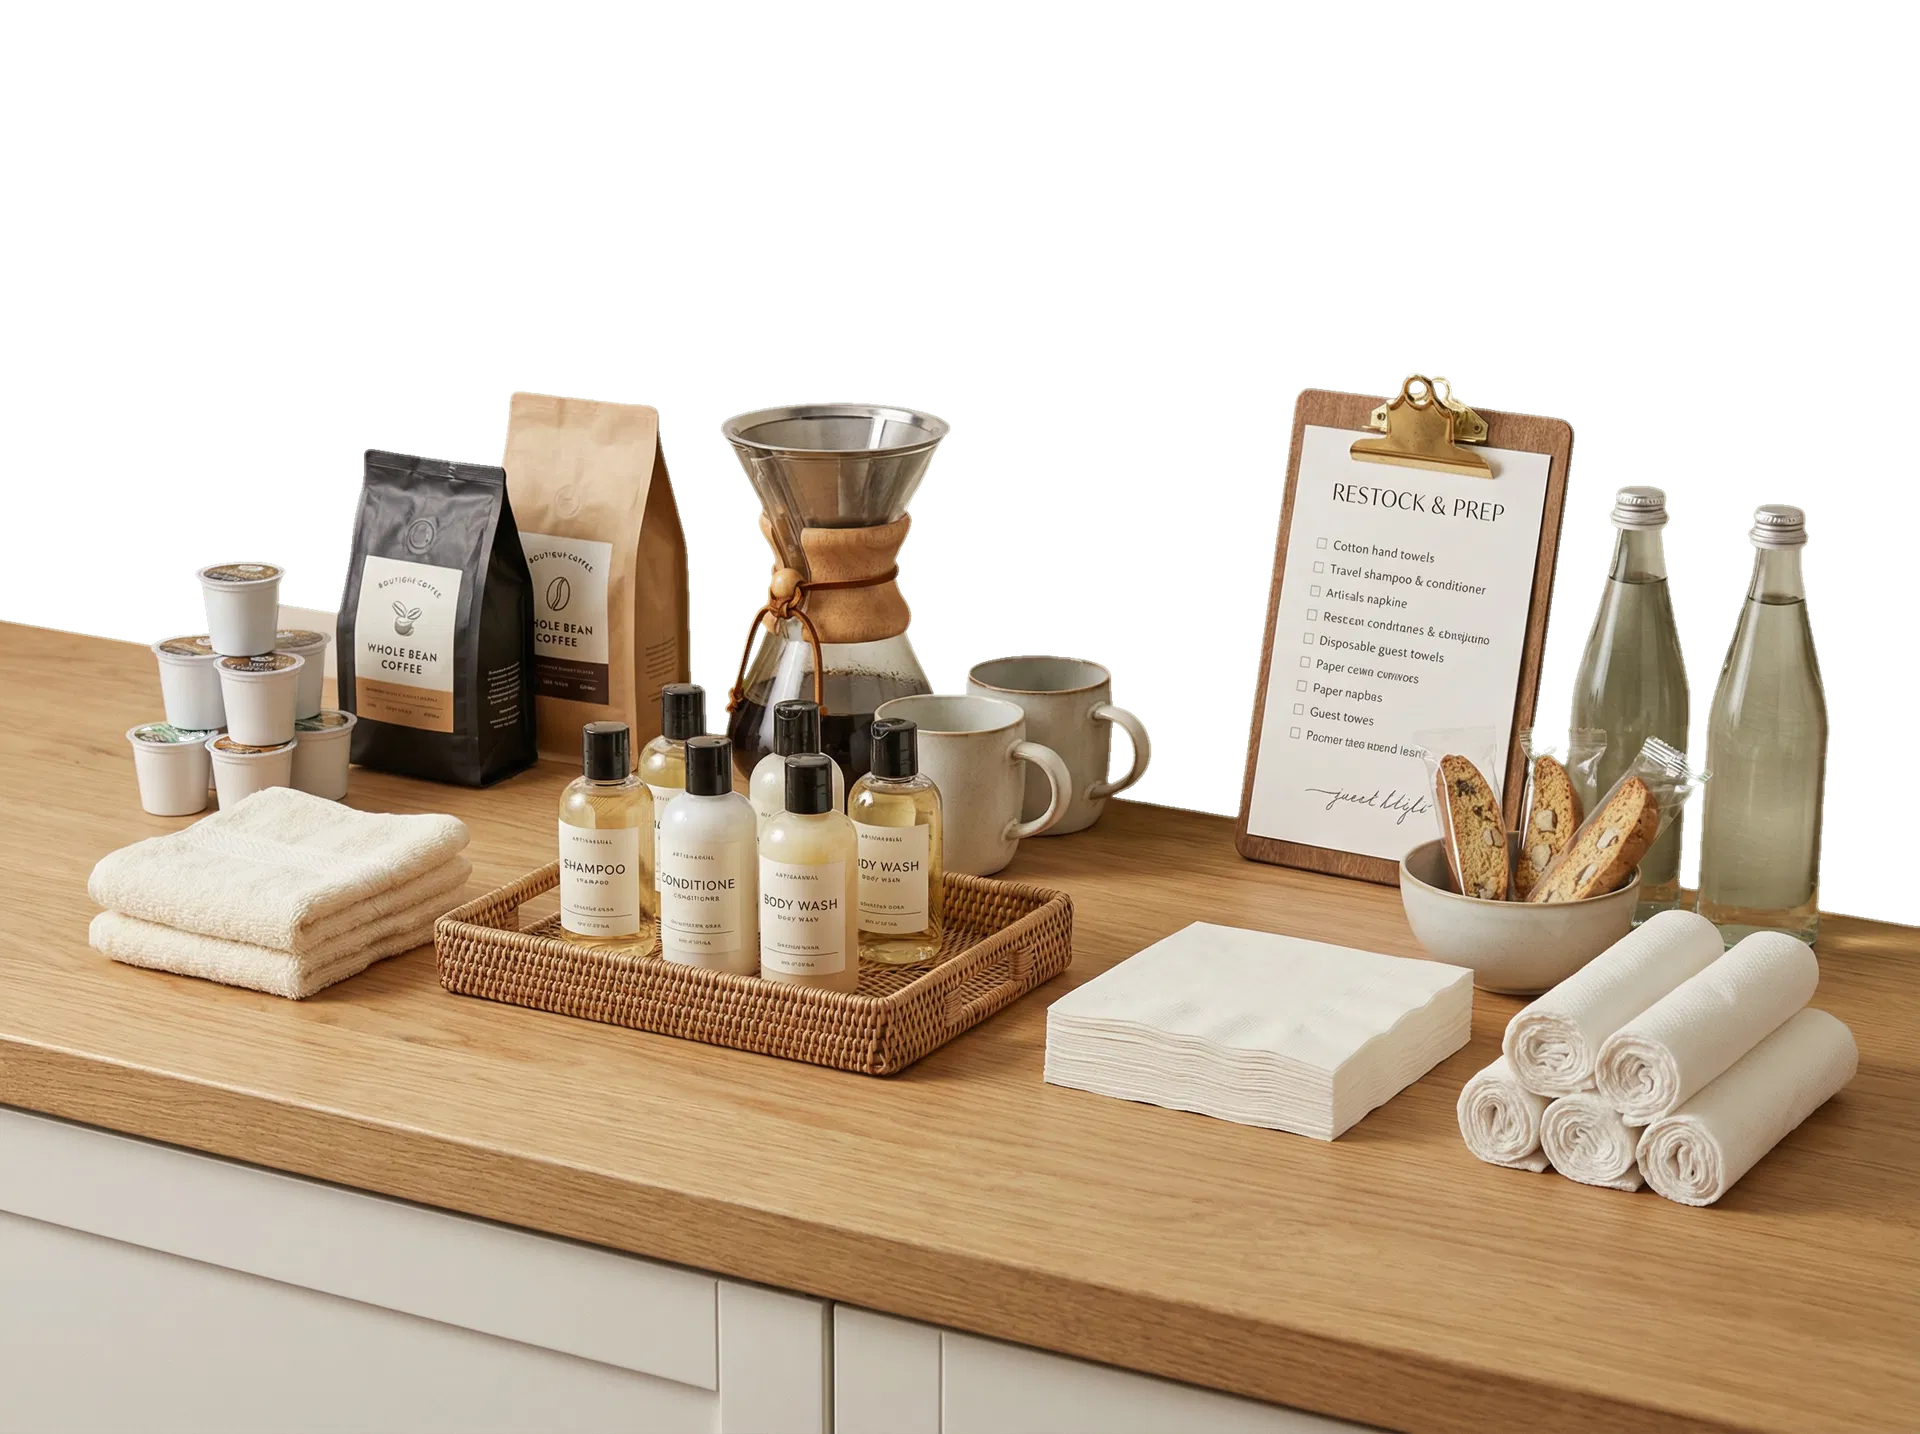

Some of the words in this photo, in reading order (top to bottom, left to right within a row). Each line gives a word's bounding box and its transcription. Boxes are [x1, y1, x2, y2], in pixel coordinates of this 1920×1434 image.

[1332, 482, 1426, 512] RESTOCK
[1431, 496, 1446, 516] &
[1453, 498, 1505, 522] PREP
[1333, 540, 1369, 555] Cotton
[1372, 544, 1398, 558] hand
[1400, 551, 1435, 563] towels
[1330, 563, 1362, 578] Travel
[1364, 569, 1412, 586] shampoo
[1415, 575, 1424, 587] &
[1426, 578, 1486, 596] conditioner
[1367, 595, 1408, 609] napkine
[533, 619, 560, 631] HOLE
[563, 623, 593, 635] BEAN
[1427, 626, 1435, 637] &
[536, 632, 577, 647] COFFEE
[367, 642, 405, 658] WHOLE
[408, 649, 437, 662] BEAN
[1319, 635, 1376, 652] Disposable
[1378, 645, 1407, 657] guest
[1410, 650, 1444, 663] towels
[381, 659, 422, 674] COFFEE
[1316, 659, 1345, 673] Paper
[1313, 683, 1343, 697] Paper
[1310, 707, 1341, 721] Guest
[1343, 713, 1374, 726] towes
[564, 858, 625, 875] SHAMPOO
[858, 858, 877, 870] DY
[880, 861, 919, 872] WASH
[764, 893, 793, 910] BODY
[798, 898, 838, 911] WASH
